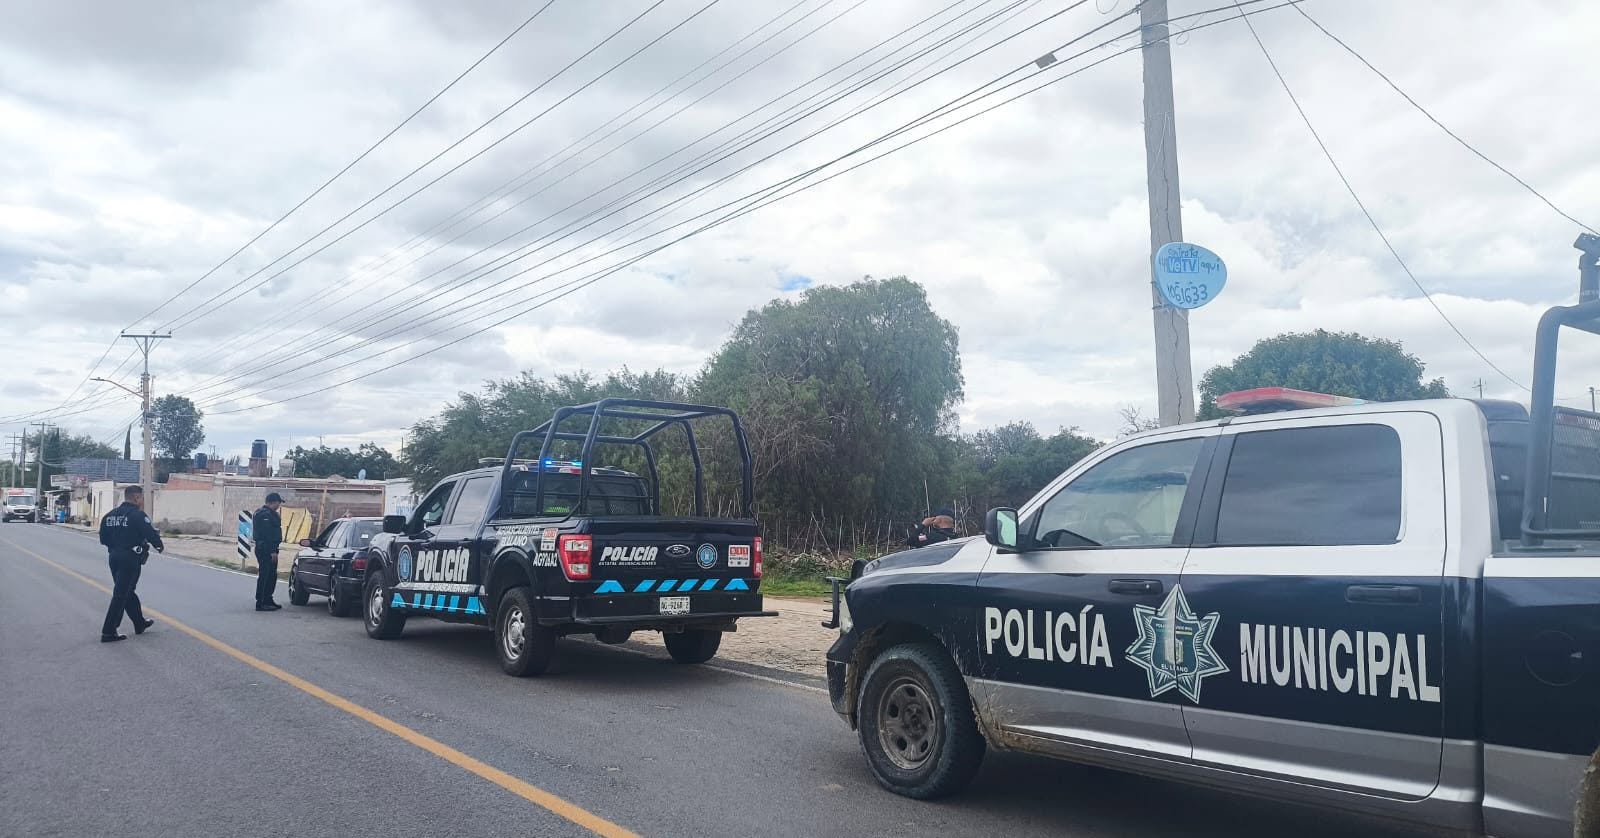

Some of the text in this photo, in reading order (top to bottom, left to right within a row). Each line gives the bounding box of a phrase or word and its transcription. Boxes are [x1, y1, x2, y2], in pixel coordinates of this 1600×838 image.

[416, 546, 470, 581] POLICÍA
[600, 545, 658, 562] POLICÍA
[984, 604, 1441, 703] POLICÍA MUNICIPAL
